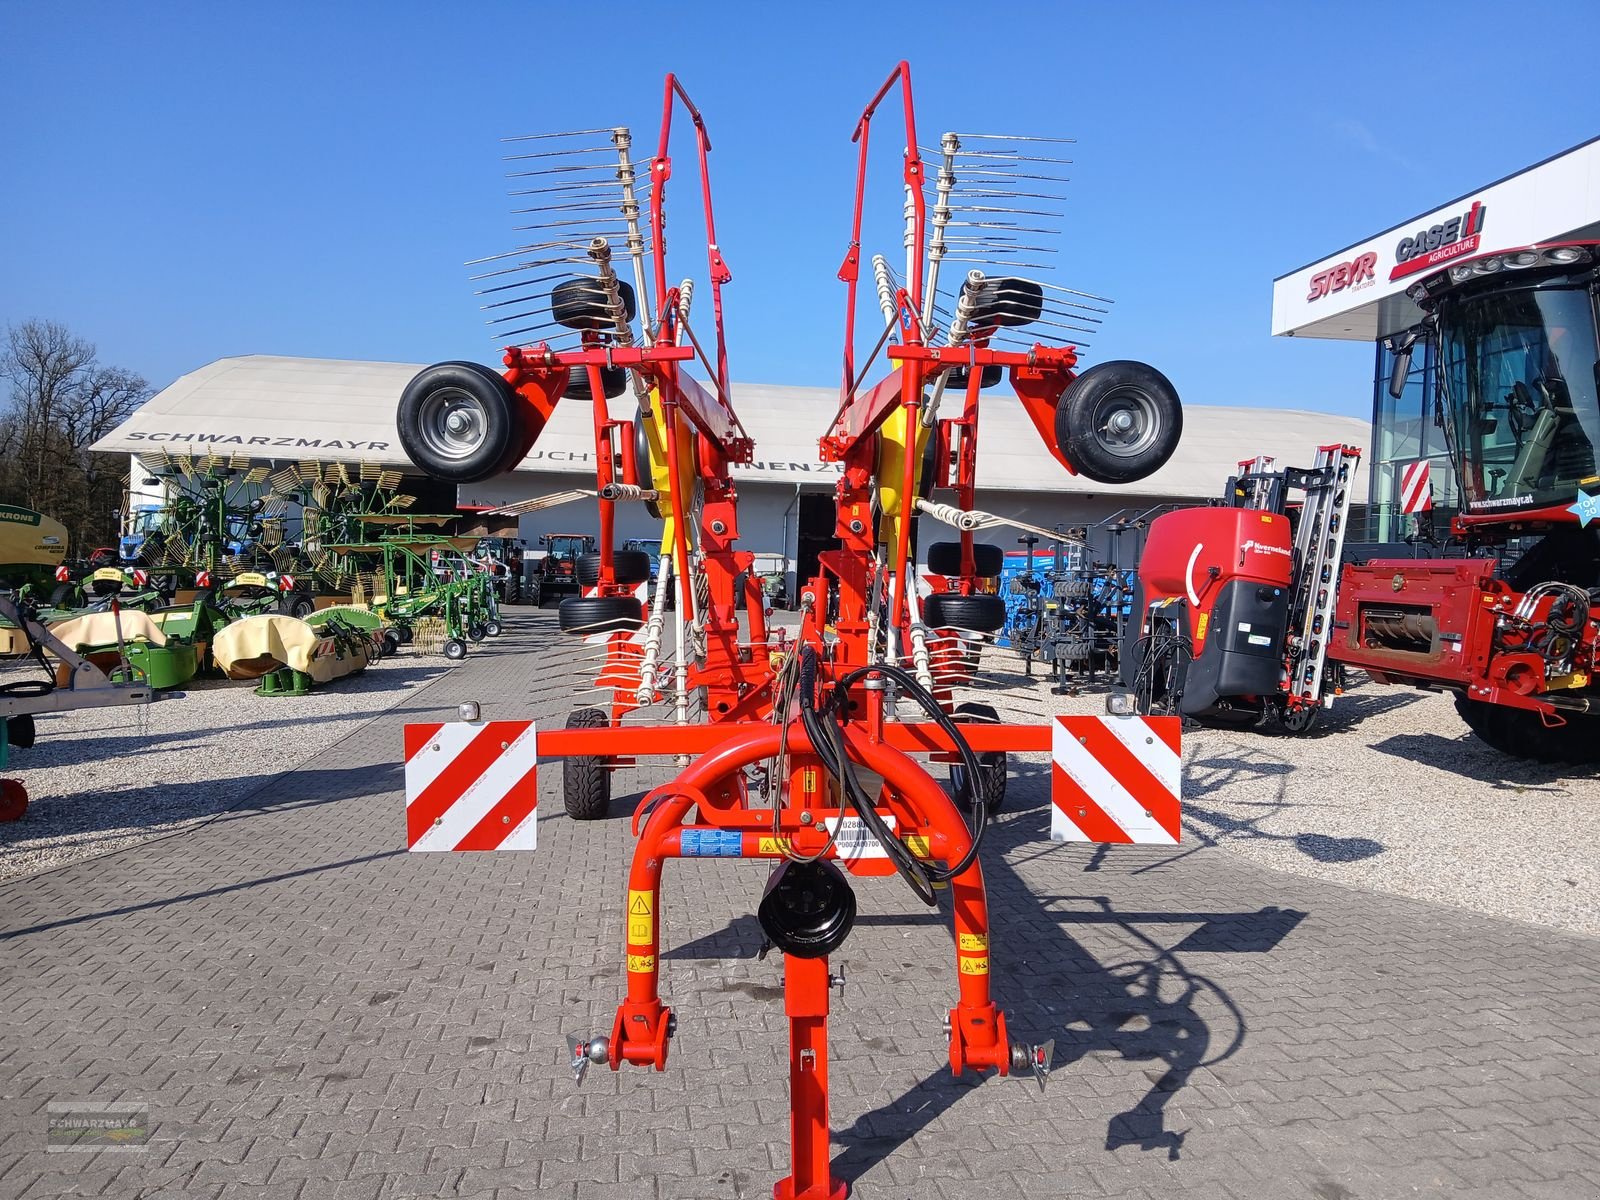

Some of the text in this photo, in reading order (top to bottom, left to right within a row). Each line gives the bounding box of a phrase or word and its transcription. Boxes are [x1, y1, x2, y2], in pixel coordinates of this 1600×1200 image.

[1396, 216, 1461, 263] CASE
[1428, 237, 1475, 263] AGRICULTURE
[1307, 251, 1378, 302] STEYR
[125, 431, 390, 450] SCHWARZMAYR
[1469, 493, 1534, 509] www.schwarzmayr.at
[1577, 497, 1597, 510] TOP
[0, 512, 34, 521] KRONE
[1584, 507, 1598, 517] 20
[1254, 542, 1291, 556] Kverneland
